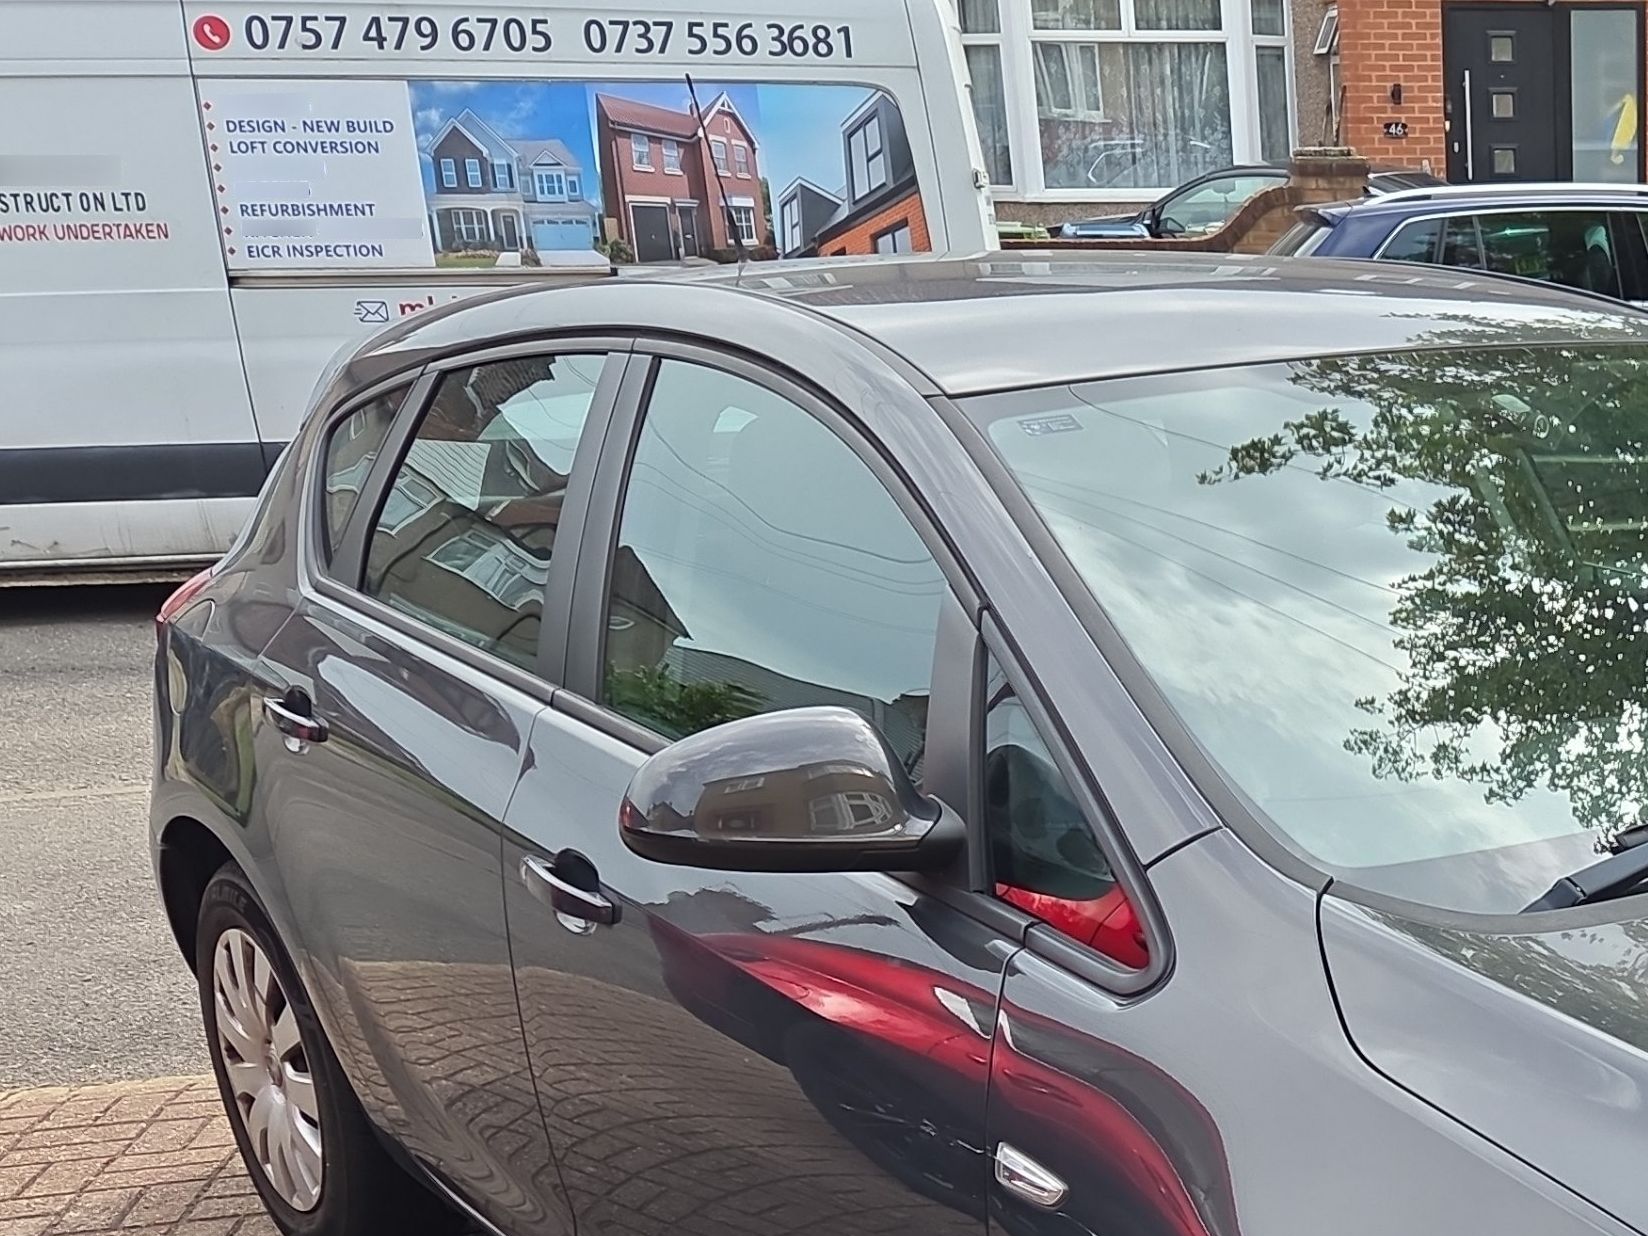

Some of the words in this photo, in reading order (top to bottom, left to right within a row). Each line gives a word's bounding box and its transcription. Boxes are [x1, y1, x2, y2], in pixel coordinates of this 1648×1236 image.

[245, 15, 347, 50] 0757
[362, 16, 439, 51] 479
[451, 17, 552, 52] 6705
[583, 19, 674, 54] 0737
[687, 21, 758, 56] 556
[766, 23, 853, 58] 3681
[225, 120, 286, 133] DESIGN
[302, 120, 341, 133] NEW
[346, 121, 394, 133] BUILD
[1389, 123, 1404, 136] 46
[229, 141, 267, 154] LOFT
[272, 141, 380, 154] CONVERSION
[111, 192, 147, 212] LTD
[240, 203, 376, 217] REFURBISHMENT
[0, 225, 49, 241] WORK
[54, 223, 169, 240] UNDERTAKEN
[247, 245, 283, 258] EICR
[287, 244, 384, 258] INSPECTION
